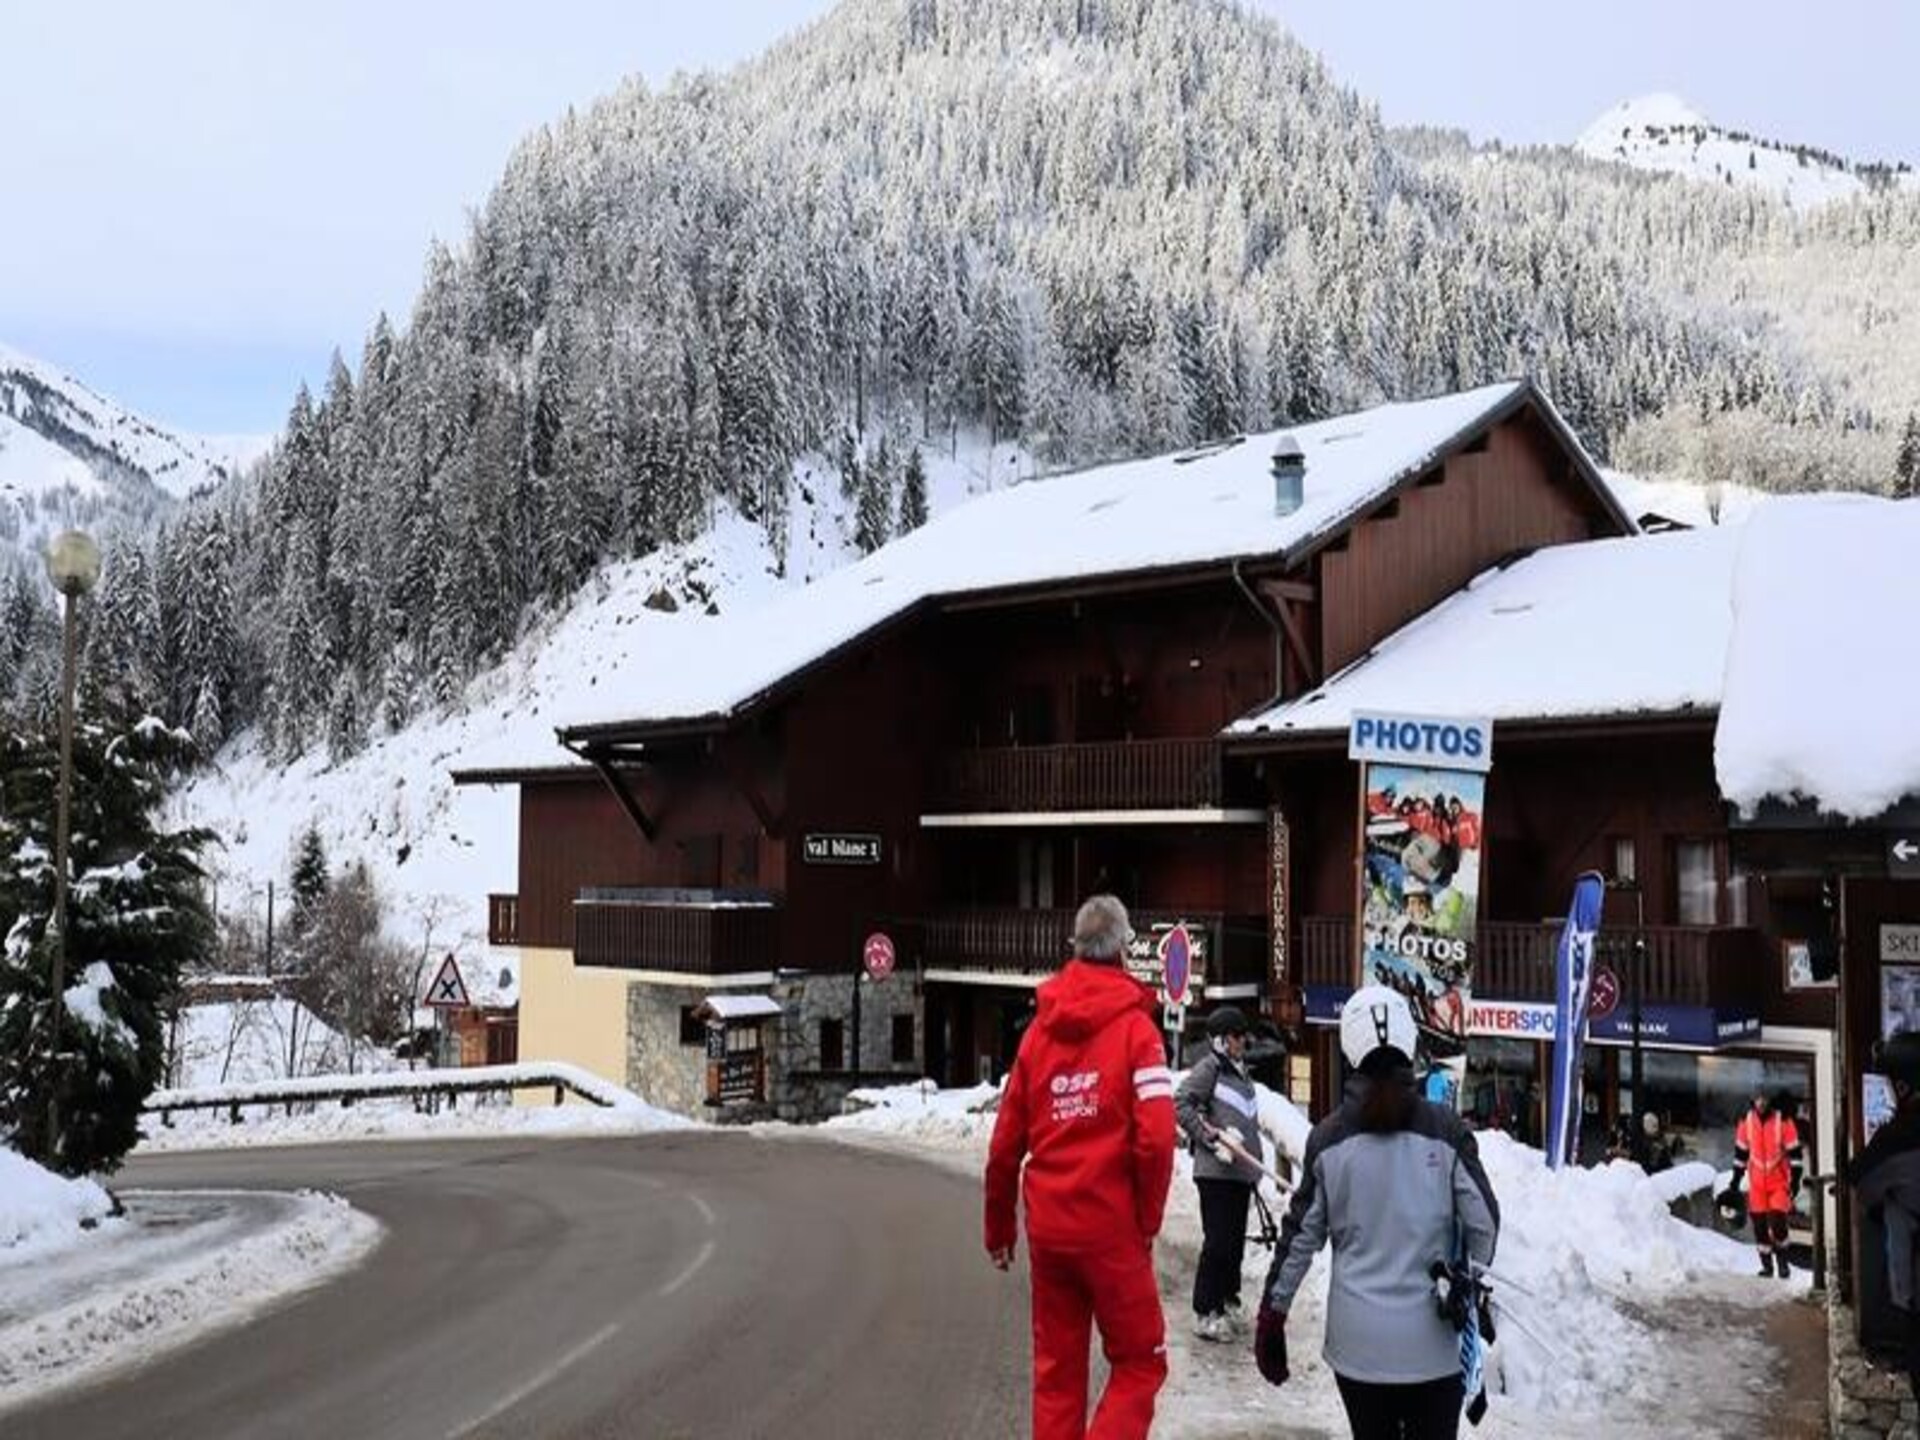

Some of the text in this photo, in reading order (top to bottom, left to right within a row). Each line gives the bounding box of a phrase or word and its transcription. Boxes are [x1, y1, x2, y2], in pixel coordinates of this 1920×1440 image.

[1356, 719, 1483, 757] PHOTOS
[832, 839, 867, 856] blanc
[1273, 812, 1286, 980] RESTAURANT
[1368, 931, 1467, 961] PHOTOS
[1465, 1008, 1555, 1033] INTERSPO
